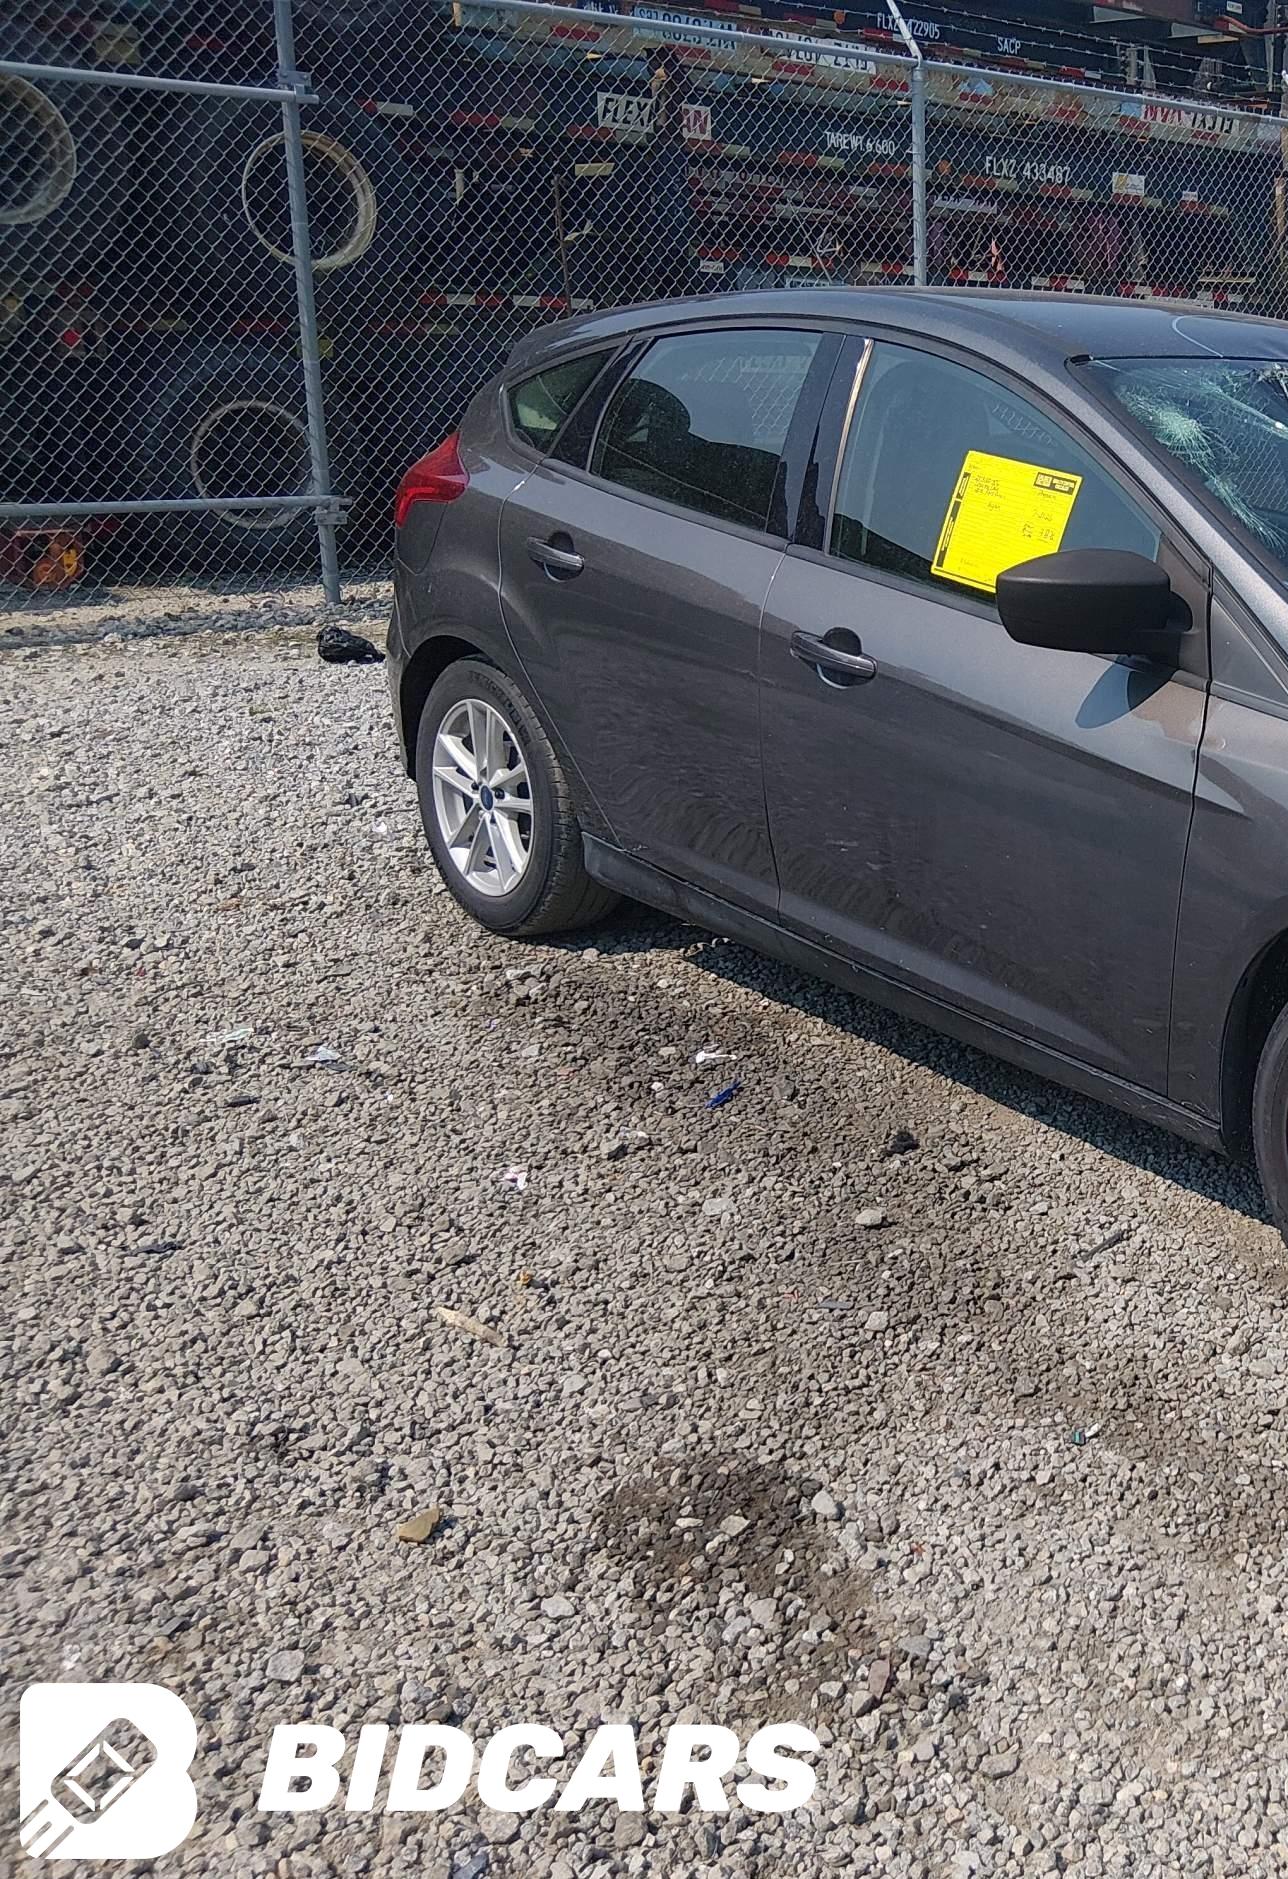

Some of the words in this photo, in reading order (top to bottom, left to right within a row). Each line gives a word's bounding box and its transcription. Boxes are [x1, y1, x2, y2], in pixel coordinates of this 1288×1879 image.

[997, 37, 1021, 55] SACP
[985, 156, 1017, 178] FLXZ
[1023, 161, 1071, 185] 433487
